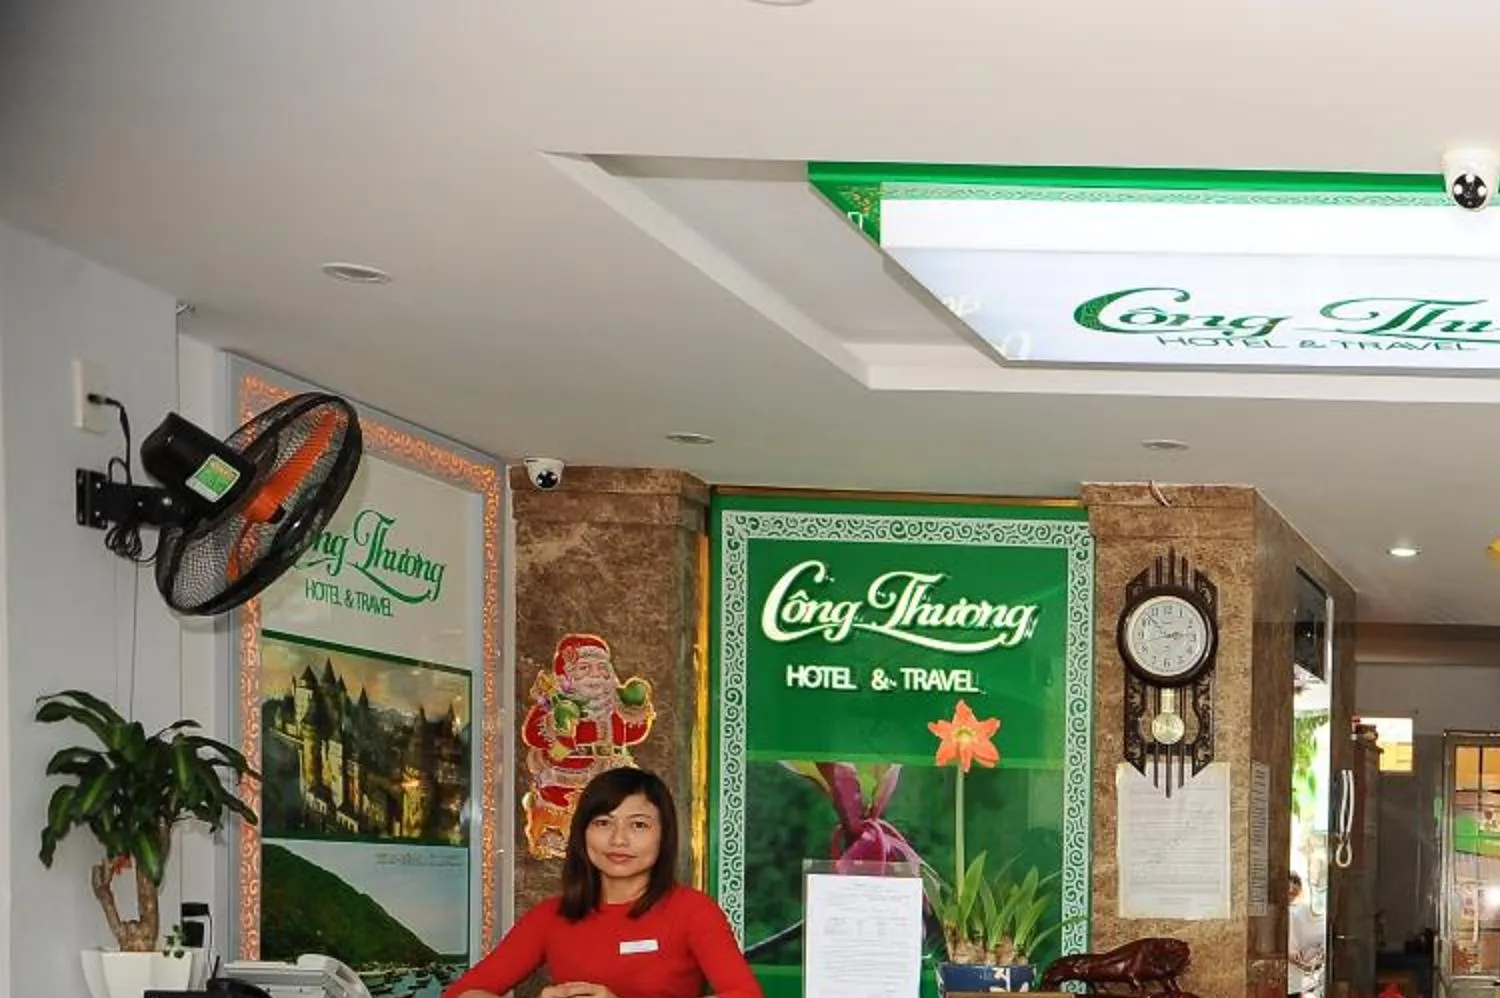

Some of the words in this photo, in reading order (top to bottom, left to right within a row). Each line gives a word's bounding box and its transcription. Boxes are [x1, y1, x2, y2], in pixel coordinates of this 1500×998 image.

[1073, 287, 1291, 337] Công
[1157, 336, 1289, 348] HOTEL
[1300, 339, 1325, 348] &
[1330, 340, 1479, 352] TRAVEL
[305, 578, 341, 606] HOTEL
[345, 589, 353, 608] &
[356, 592, 393, 617] TRAVEL
[762, 560, 864, 642] Công
[787, 665, 857, 689] HOTEL
[871, 667, 889, 691] &
[900, 668, 978, 692] TRAVEL
